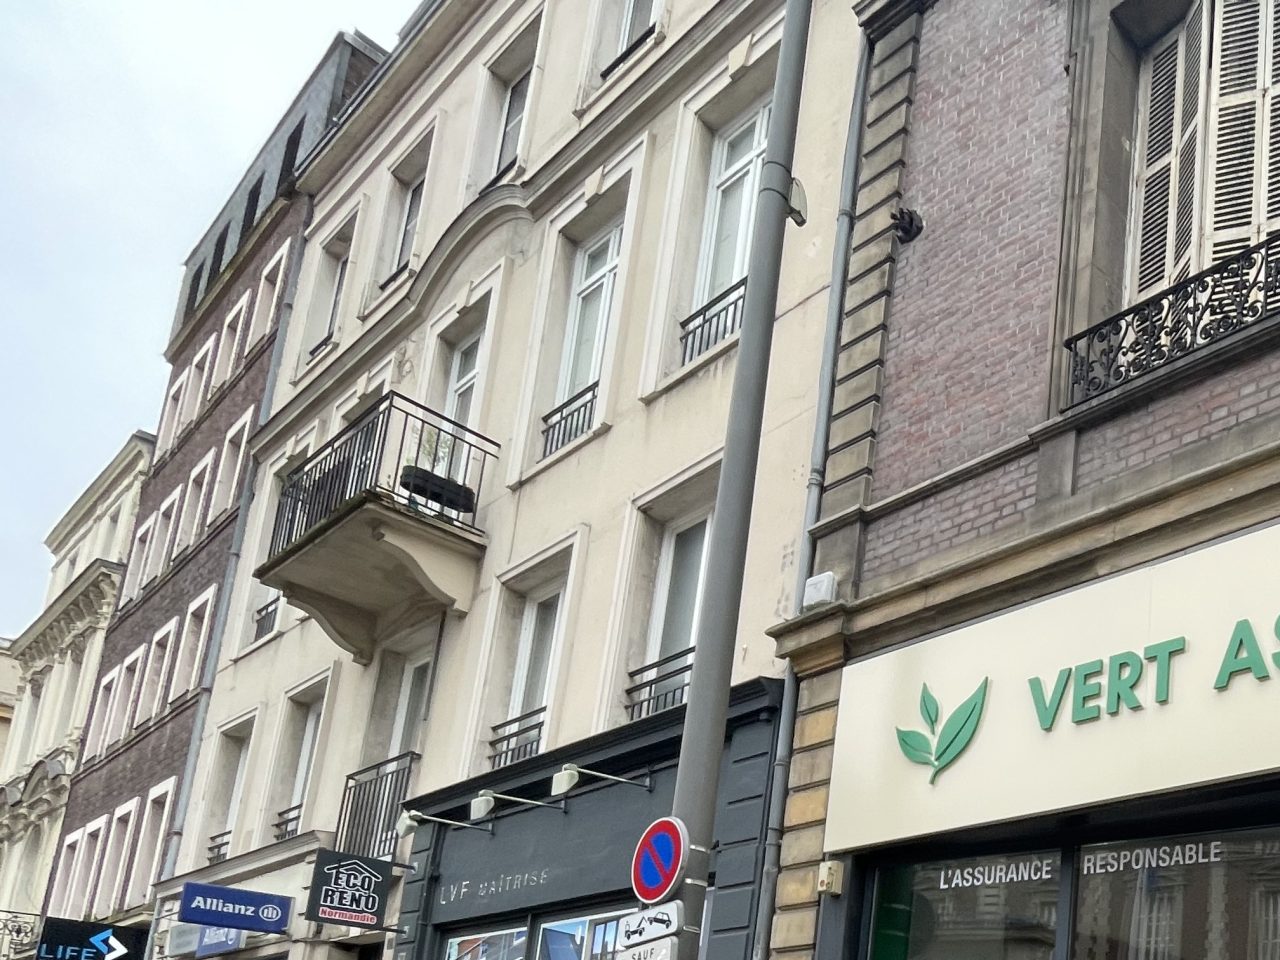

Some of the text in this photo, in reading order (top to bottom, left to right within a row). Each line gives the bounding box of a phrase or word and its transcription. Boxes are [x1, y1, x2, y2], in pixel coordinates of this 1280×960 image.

[1028, 636, 1187, 731] VERT
[939, 841, 1221, 889] L'ASSURANCE RESPONSABLE
[332, 869, 374, 892] ECO
[191, 896, 255, 916] Allianz
[321, 886, 378, 912] RENO
[320, 907, 376, 924] Normandie
